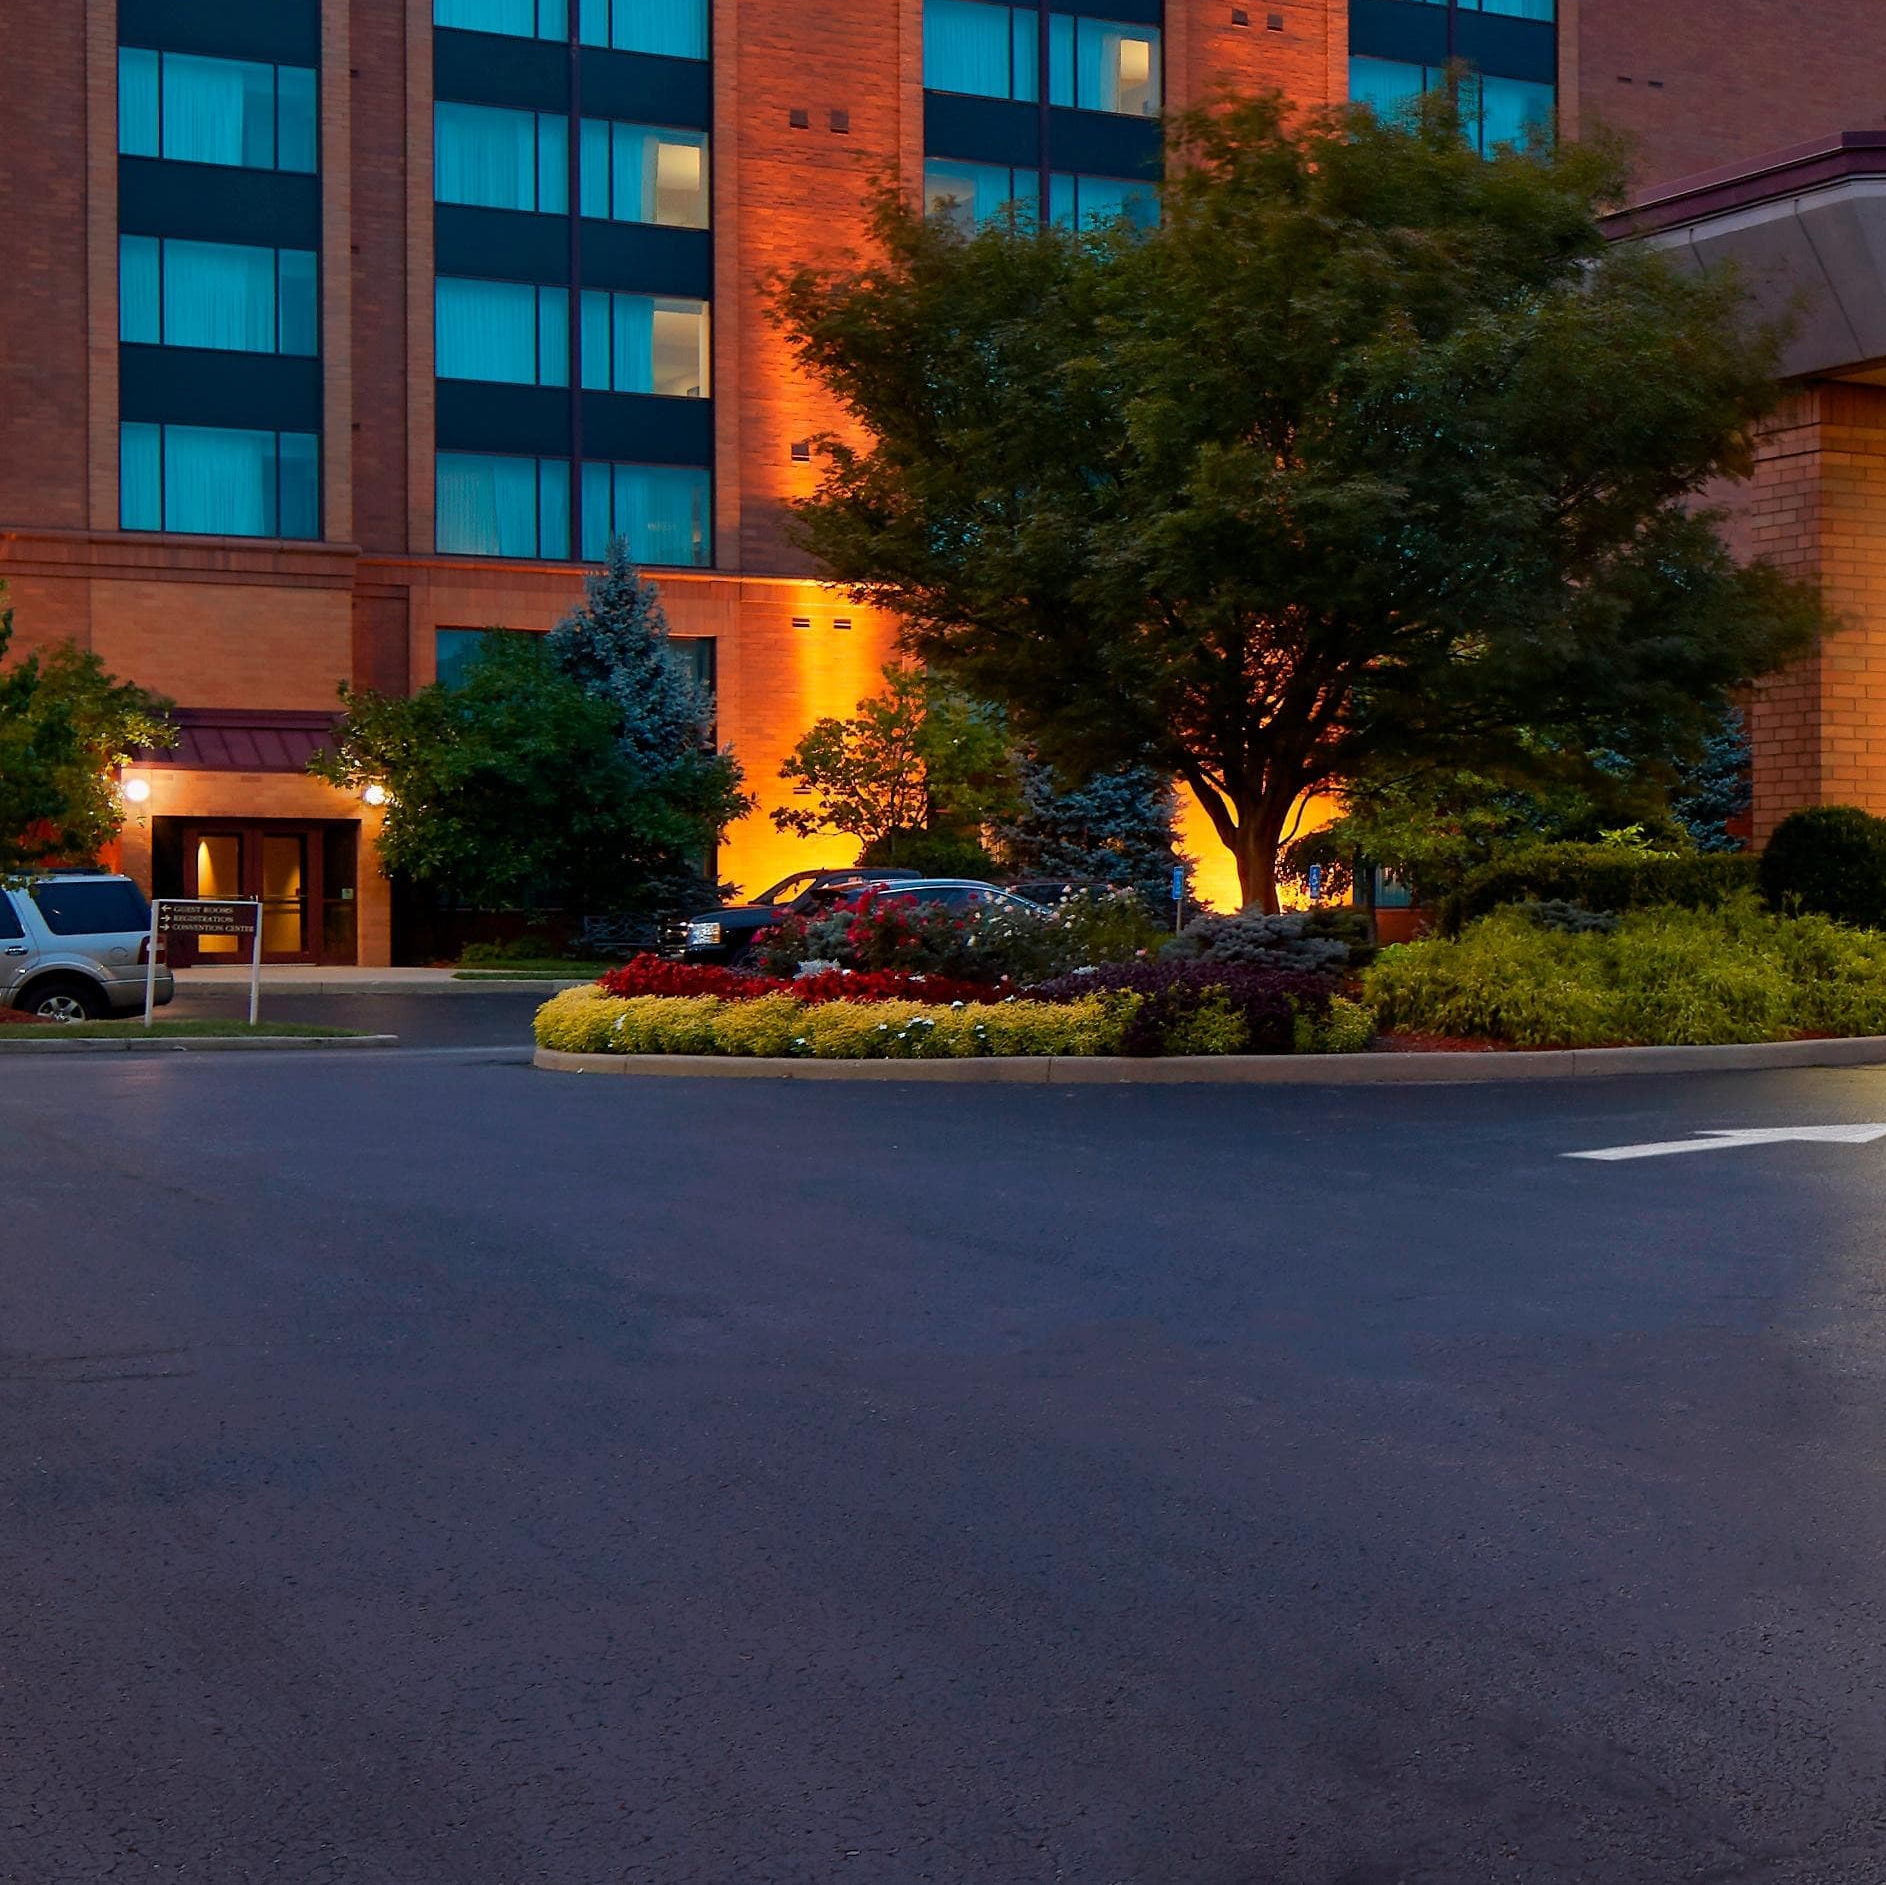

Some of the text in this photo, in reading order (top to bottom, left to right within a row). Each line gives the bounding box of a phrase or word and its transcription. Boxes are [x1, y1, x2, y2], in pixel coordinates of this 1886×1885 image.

[173, 905, 234, 914] GUEST ROOMS
[173, 915, 234, 923] REGISTRATION
[172, 923, 224, 931] CONVENTION
